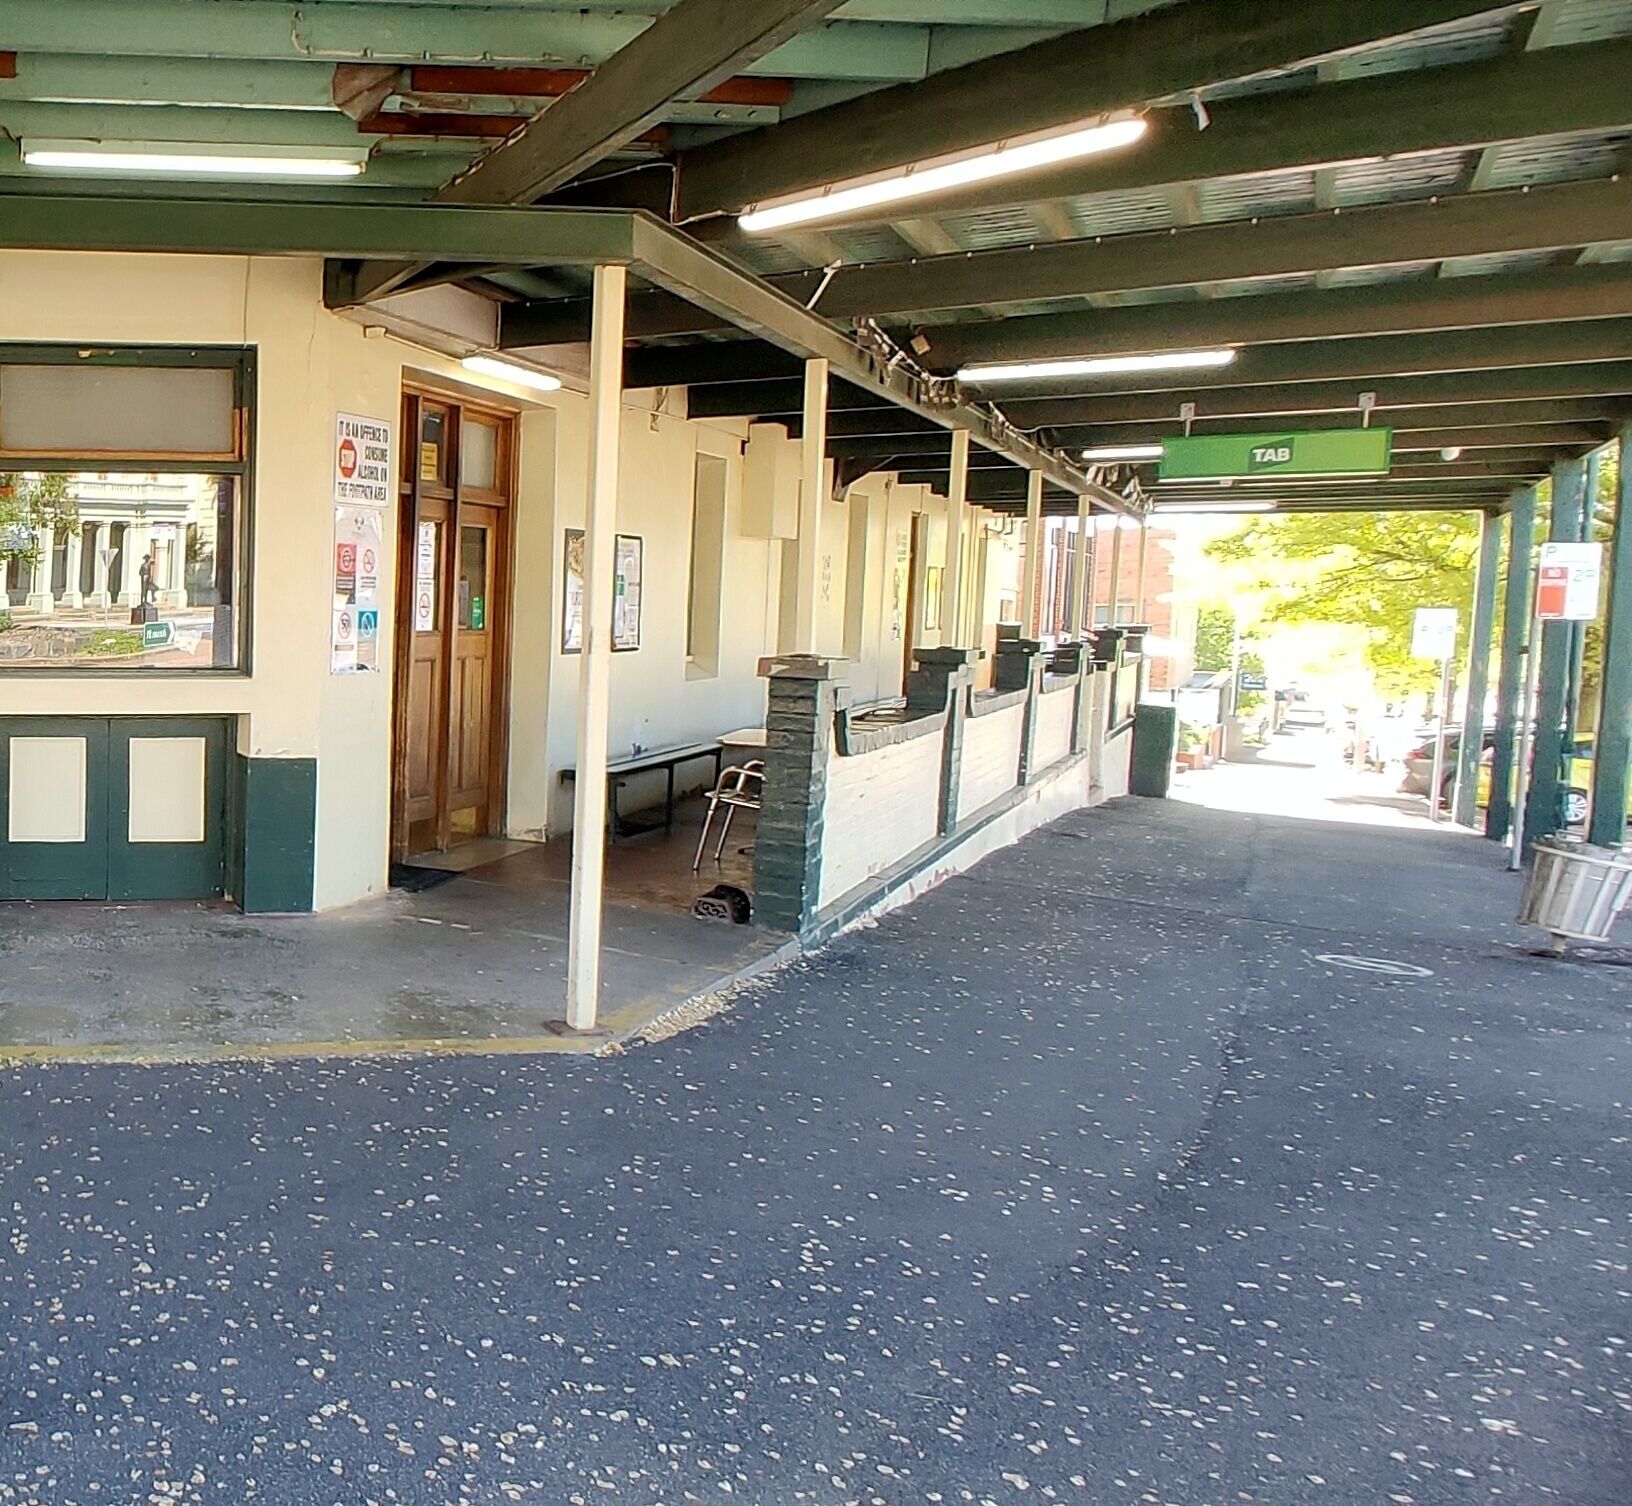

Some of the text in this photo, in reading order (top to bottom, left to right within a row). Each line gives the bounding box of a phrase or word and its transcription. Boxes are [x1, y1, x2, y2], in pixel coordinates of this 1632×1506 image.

[338, 420, 389, 444] IT IS AN OFFENCE TO
[364, 445, 388, 463] CONSUME
[1252, 447, 1290, 462] TAB
[358, 464, 388, 483] ALCOHOL ON
[337, 481, 387, 501] THE FOOTPATH AREA
